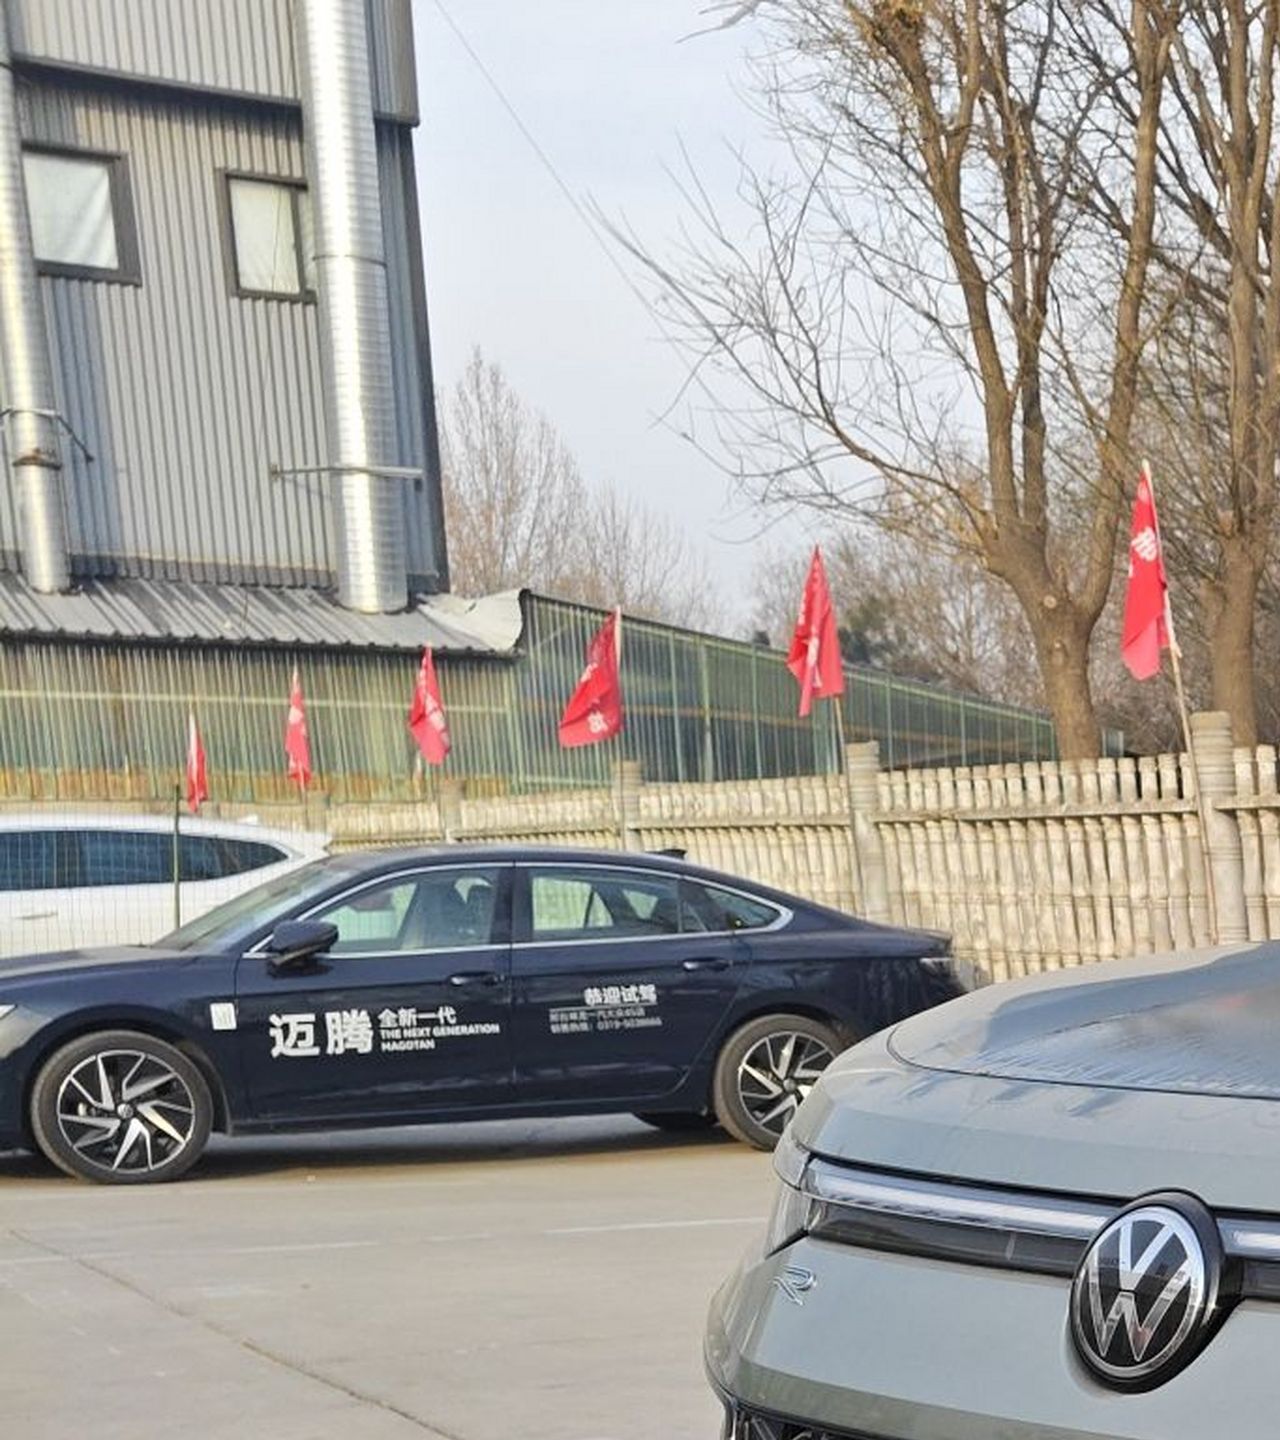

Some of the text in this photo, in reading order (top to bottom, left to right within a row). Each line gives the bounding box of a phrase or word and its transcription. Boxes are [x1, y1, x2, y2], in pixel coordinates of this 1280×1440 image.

[584, 984, 657, 1006] 恭迎试驾
[378, 1006, 457, 1028] 全新一代
[269, 1009, 374, 1057] 迈腾
[379, 1023, 500, 1039] THE NEXT GENERATION
[380, 1038, 435, 1051] MAGOTAN
